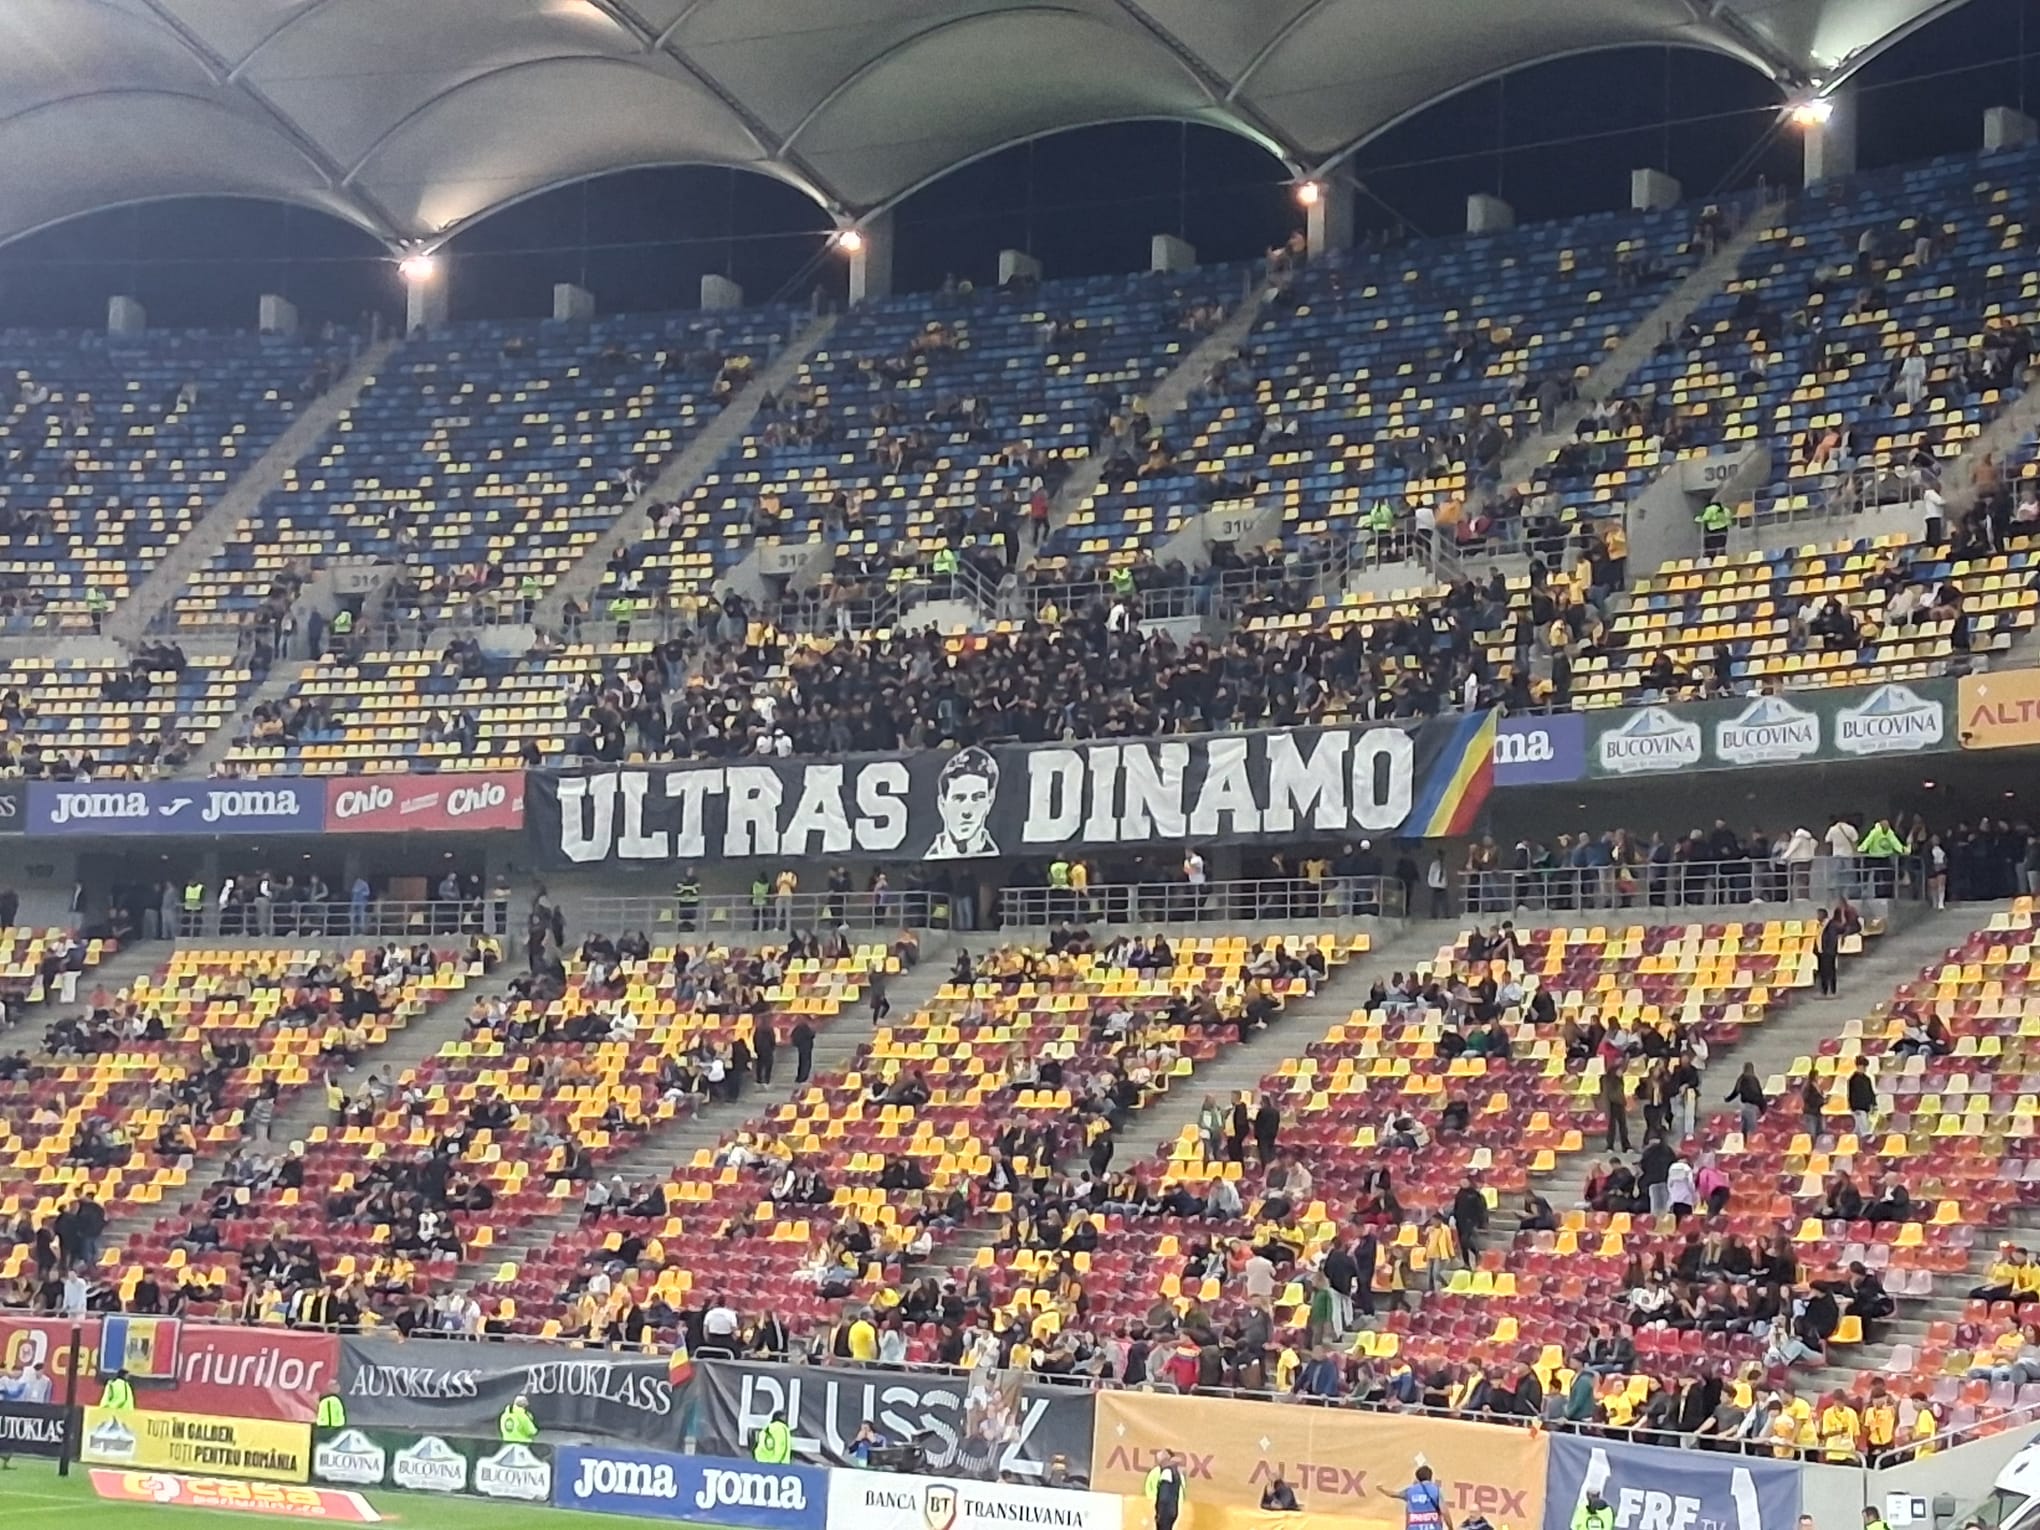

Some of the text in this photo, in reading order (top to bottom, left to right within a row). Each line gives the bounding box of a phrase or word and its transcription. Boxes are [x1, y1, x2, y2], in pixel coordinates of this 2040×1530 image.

[351, 574, 379, 587] 314
[1843, 714, 1936, 739] BUCOVINA
[1969, 700, 2040, 727] ALT
[1493, 730, 1554, 764] ma
[1607, 735, 1695, 758] BUCOVINA
[1723, 724, 1812, 748] BUCOVINA
[335, 782, 506, 818] Chio Chio
[557, 727, 1414, 862] ULTRAS DINAMO
[178, 1343, 324, 1391] riurilor
[349, 1362, 673, 1416] AUTOKLASS AUTOKLASS
[0, 1416, 65, 1443] UTOKLAS
[194, 1445, 241, 1467] PENTRU
[318, 1453, 381, 1473] BUCOVINA
[399, 1460, 462, 1479] BUCOVINA
[480, 1467, 546, 1487] BUCOVINA
[865, 1490, 1083, 1527] BANCA BT TRANSILVANIA
